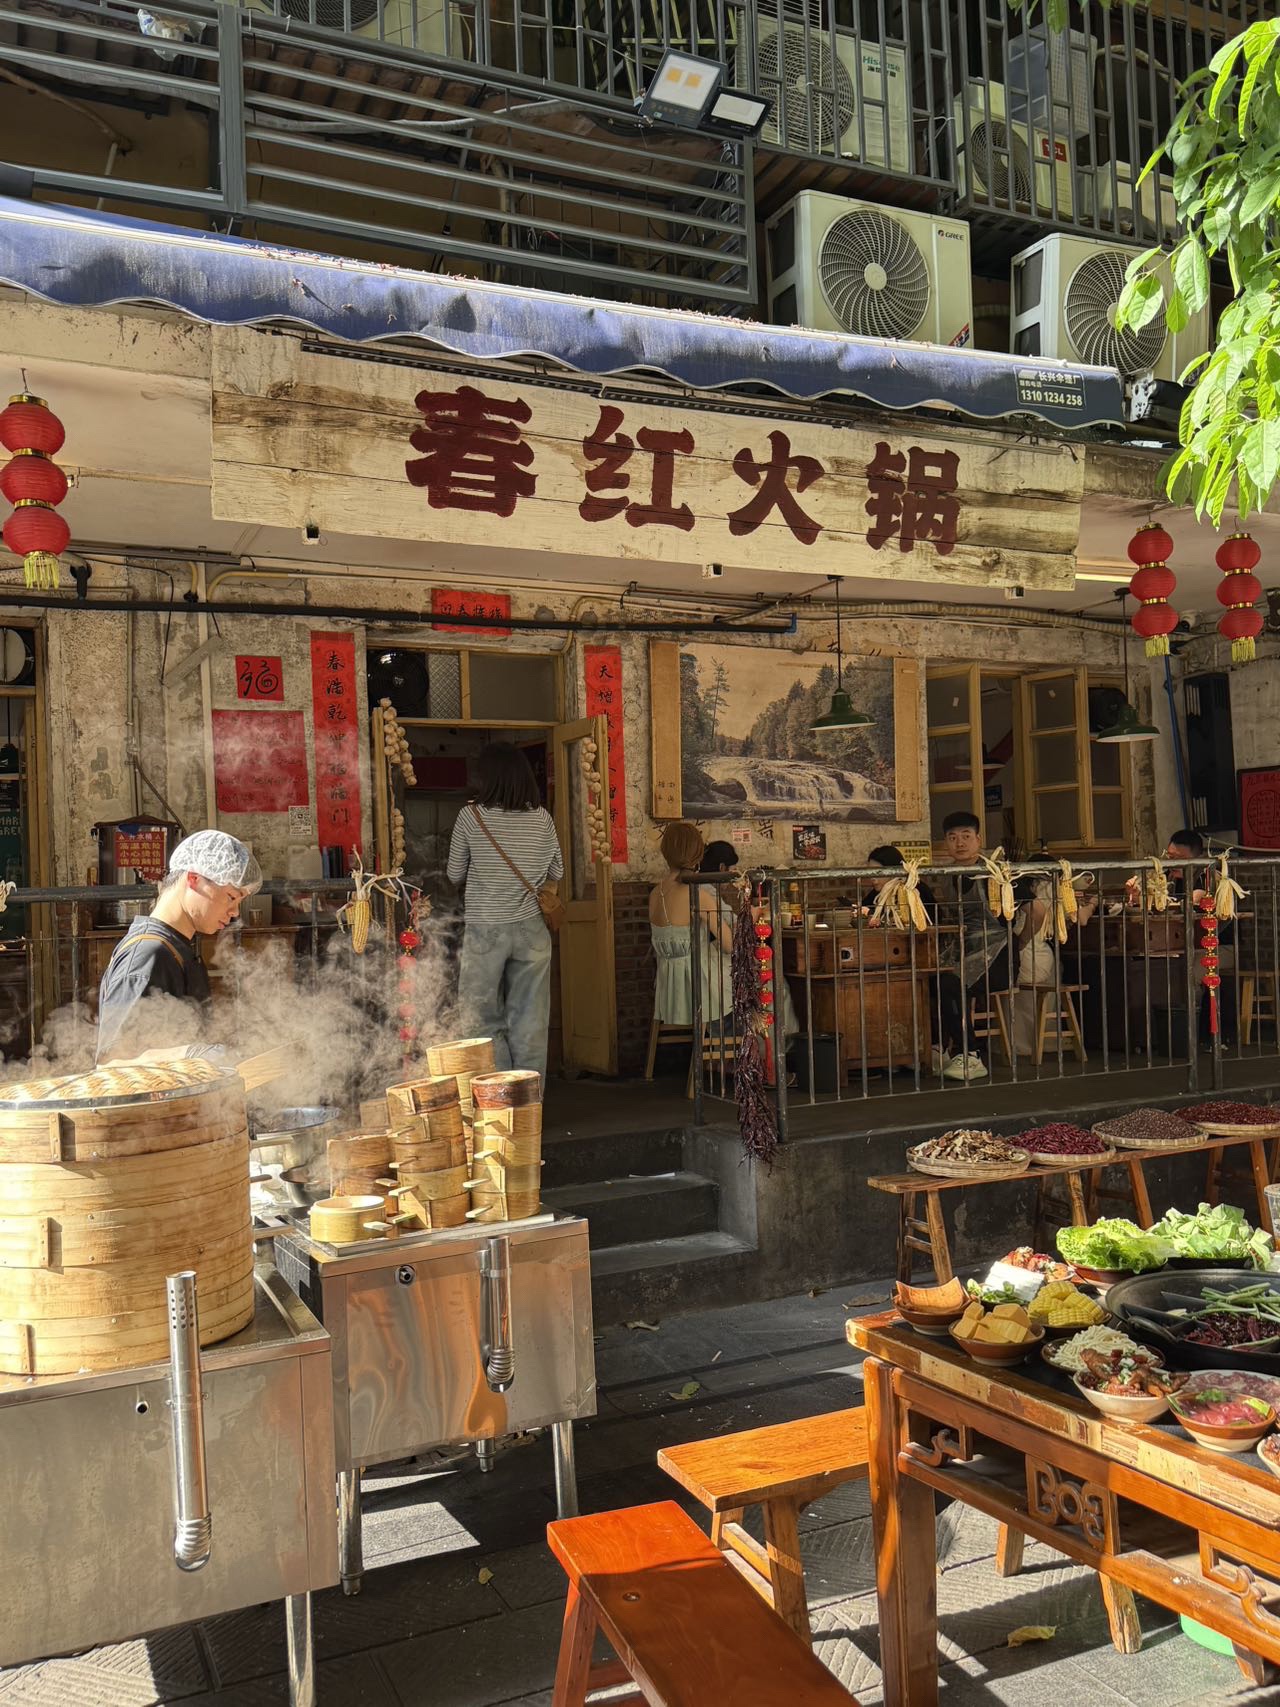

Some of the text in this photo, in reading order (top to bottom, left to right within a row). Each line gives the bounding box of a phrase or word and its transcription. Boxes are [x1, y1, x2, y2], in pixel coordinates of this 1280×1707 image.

[863, 56, 900, 71] Hisnse
[945, 232, 964, 240] GREE
[1021, 390, 1083, 406] 1310 1234 258
[405, 385, 961, 556] 春红火锅
[239, 660, 279, 697] 福
